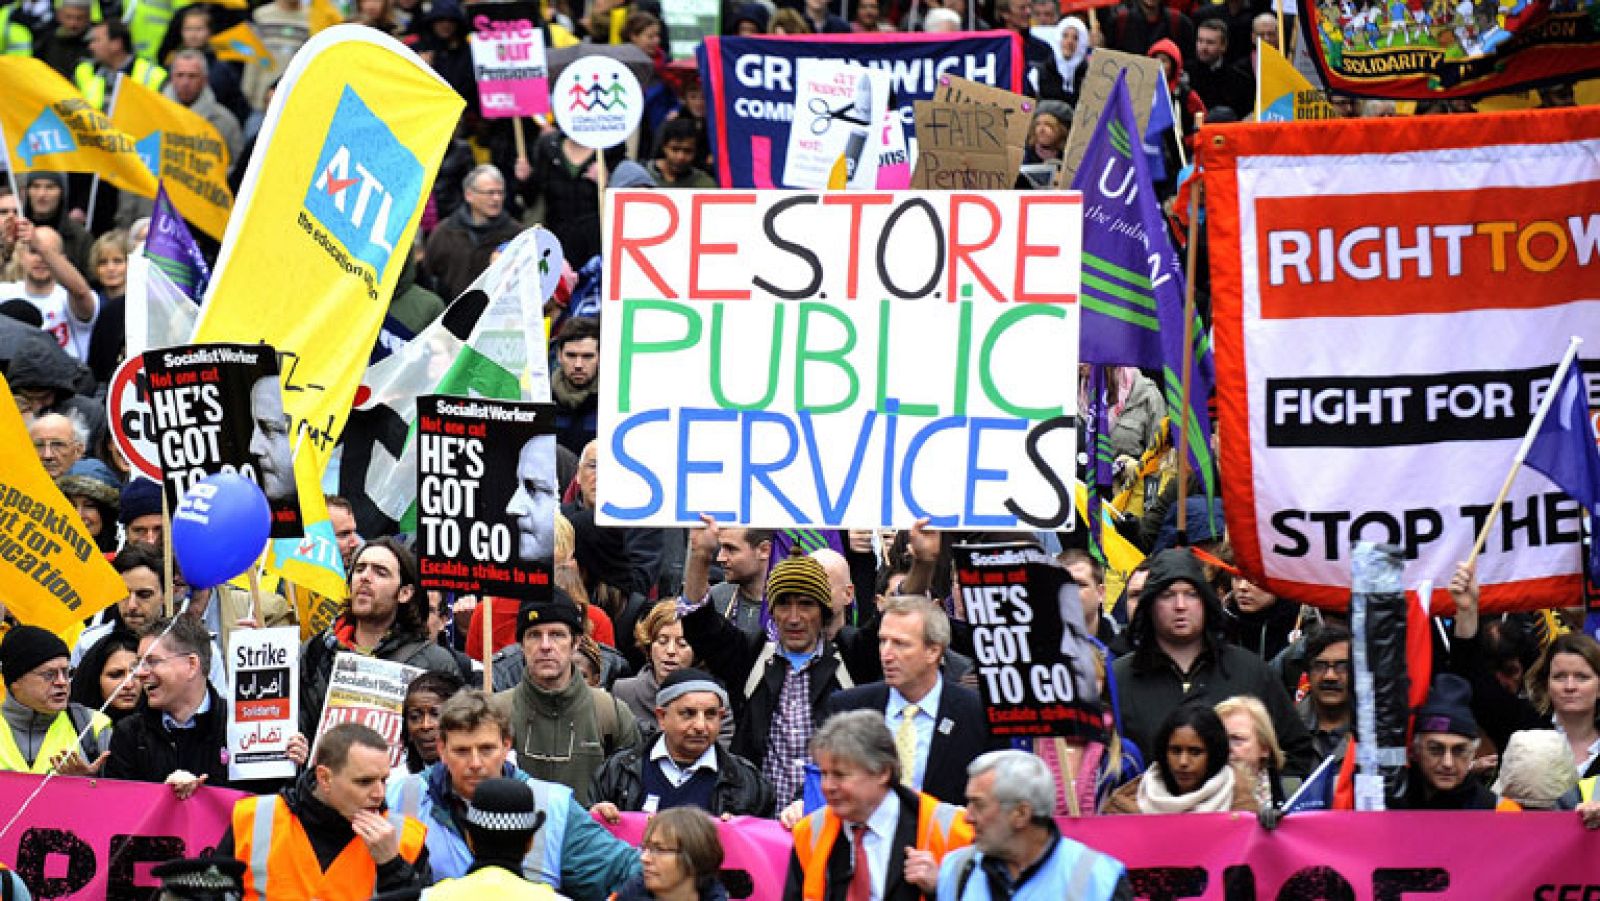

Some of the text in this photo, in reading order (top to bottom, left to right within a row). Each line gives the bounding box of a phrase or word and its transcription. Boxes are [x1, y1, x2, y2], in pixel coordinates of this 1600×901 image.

[474, 14, 533, 41] Save
[735, 52, 997, 95] GRWICH
[1342, 50, 1444, 75] SOLIDARITY
[28, 128, 69, 150] ATL
[924, 108, 1003, 149] FAIR
[315, 144, 393, 256] ATL
[298, 211, 313, 234] the
[313, 229, 364, 277] education
[1267, 224, 1474, 287] RIGHT
[1475, 220, 1569, 274] TO
[151, 371, 171, 389] Not
[175, 372, 198, 384] one
[201, 367, 221, 382] cut
[163, 348, 258, 367] Socialist Worker
[153, 383, 224, 430] HE'S
[437, 400, 536, 422] Socialist Worker
[1273, 387, 1411, 426] FIGHT
[1425, 382, 1515, 422] FOR
[161, 424, 222, 470] GOT
[420, 415, 486, 438] Not one cut
[420, 433, 484, 478] HE'S
[420, 474, 480, 518] GOT
[18, 520, 62, 558] for
[420, 516, 511, 564] TO GO
[1270, 491, 1582, 561] STOP THE
[293, 532, 346, 581] ATL
[420, 558, 549, 585] Escalate strikes to win
[961, 583, 1035, 626] HE'S
[237, 642, 287, 668] Strike
[973, 625, 1033, 666] GOT
[978, 663, 1075, 704] TO GO
